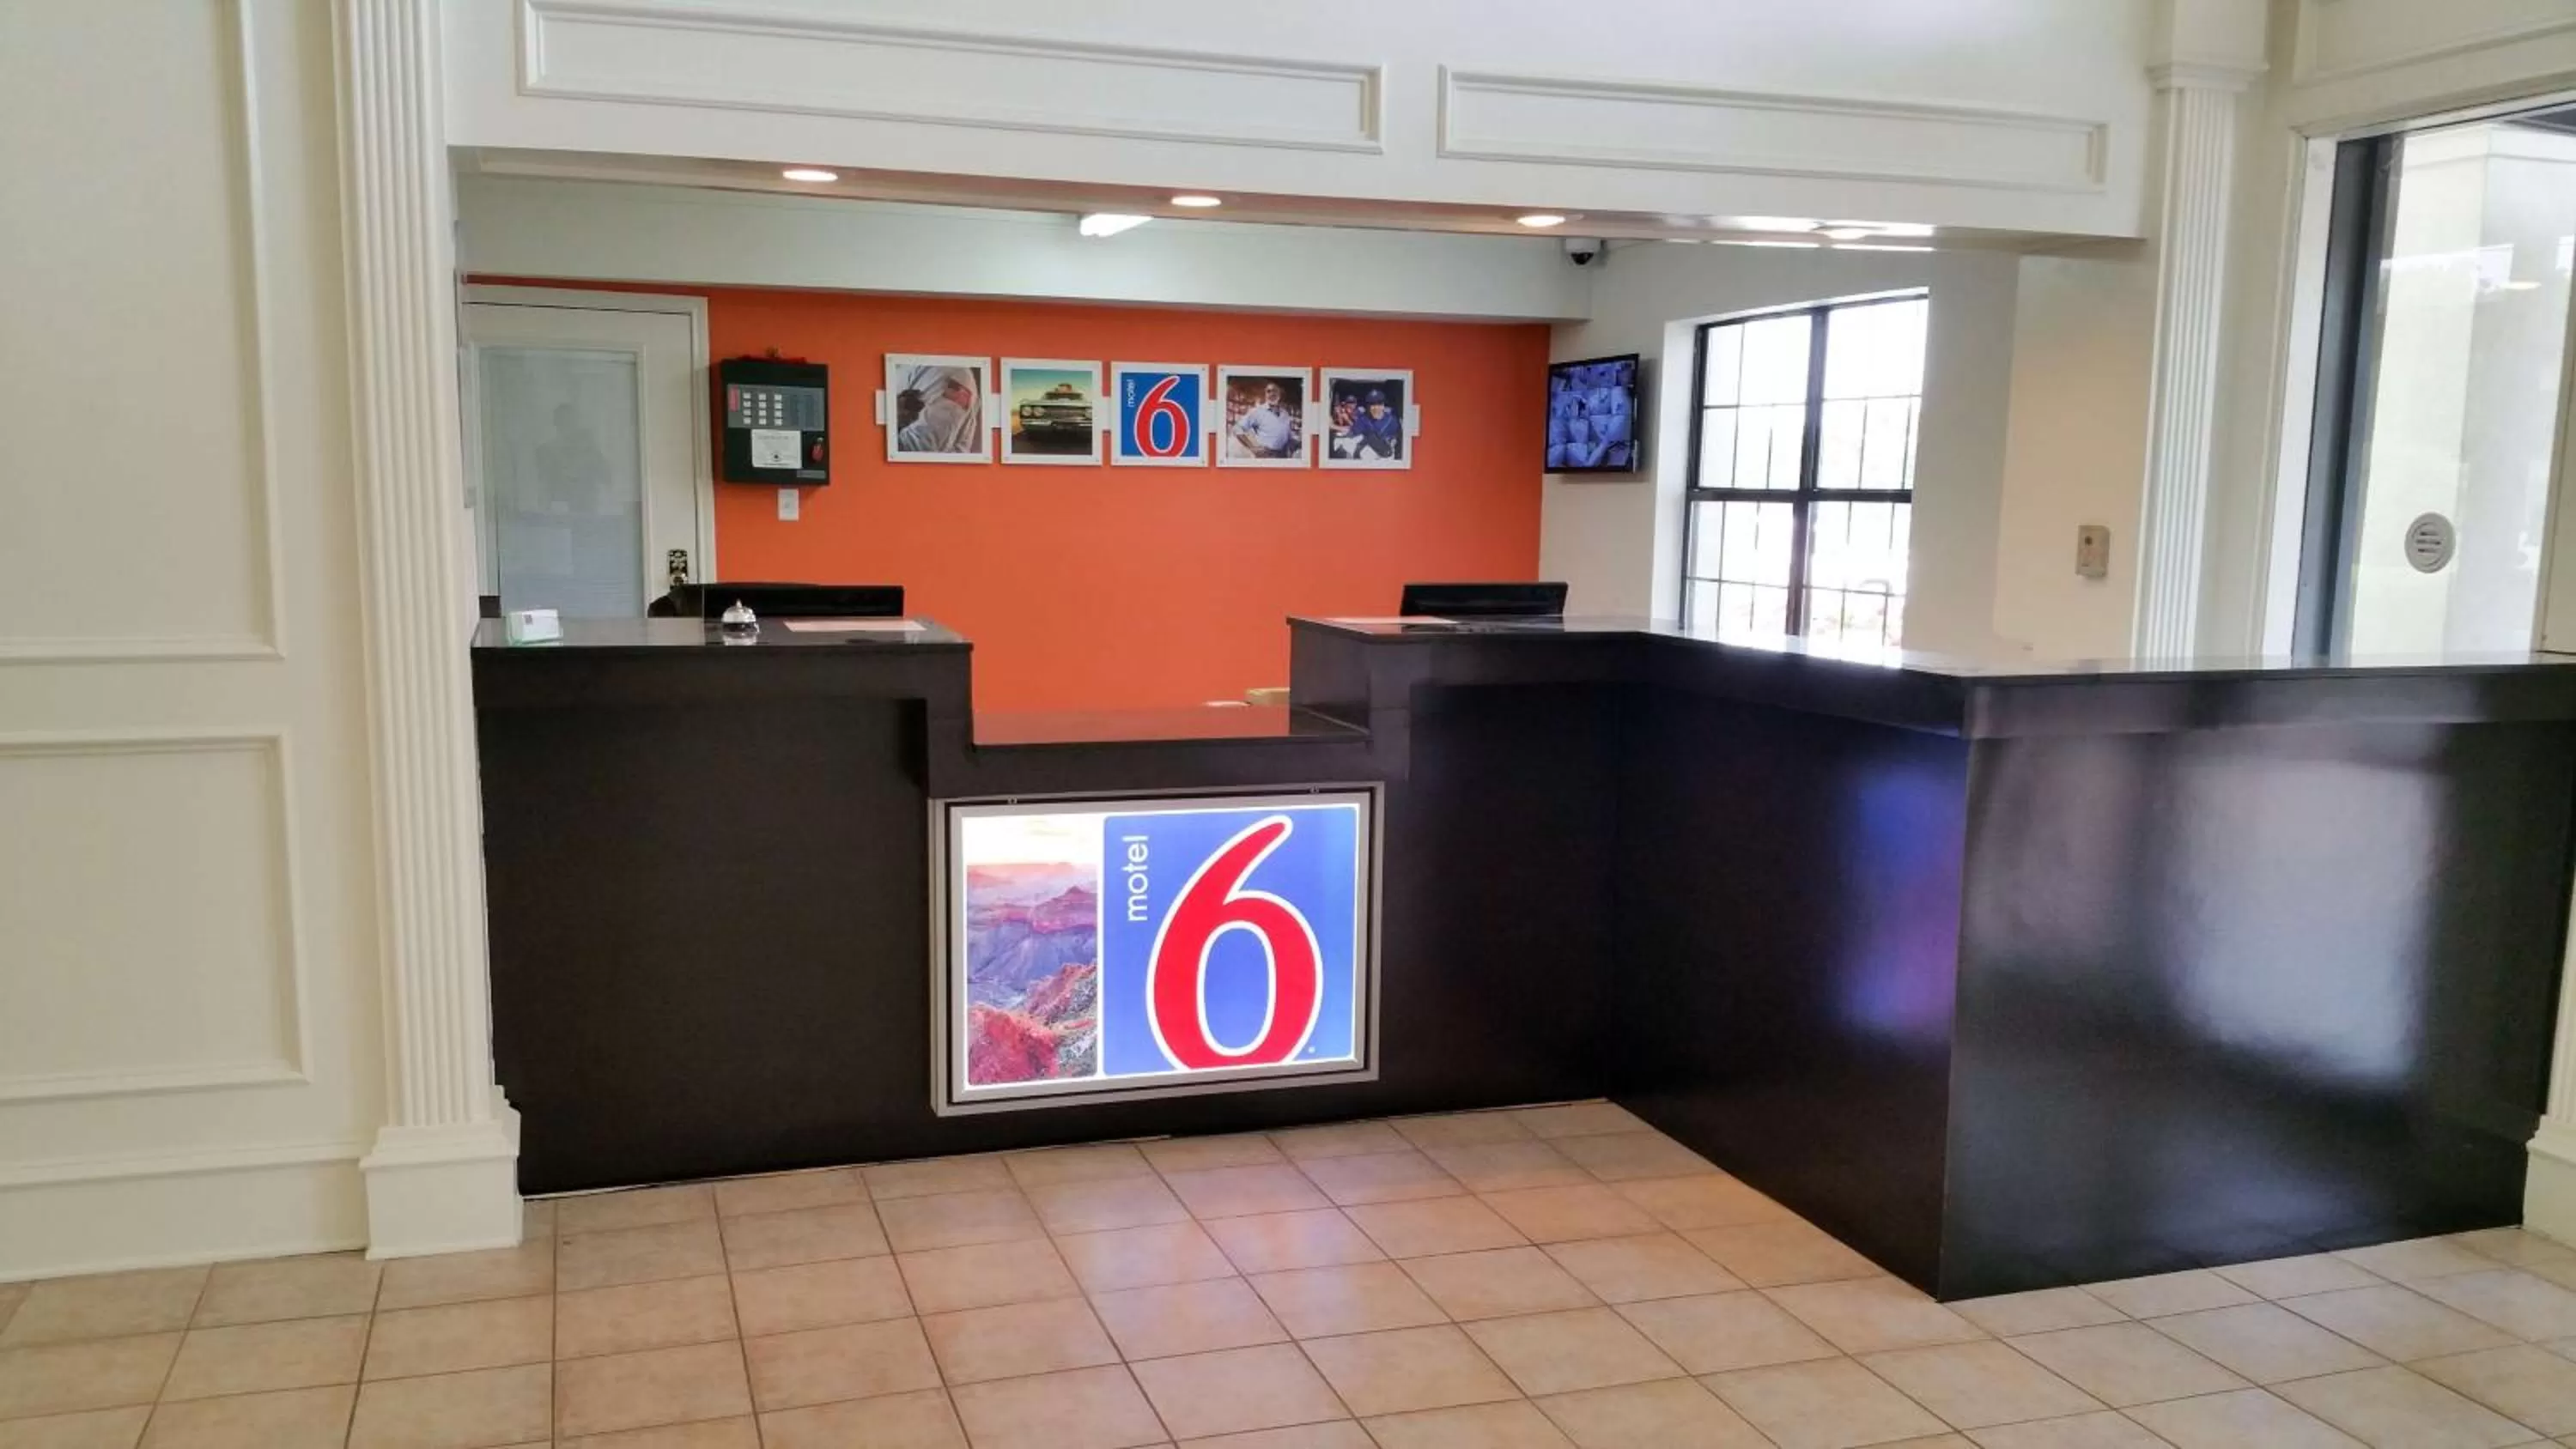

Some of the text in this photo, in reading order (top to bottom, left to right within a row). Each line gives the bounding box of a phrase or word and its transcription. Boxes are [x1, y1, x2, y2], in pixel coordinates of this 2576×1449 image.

[1127, 375, 1190, 457] motel 6
[1123, 815, 1323, 1070] motel 6
